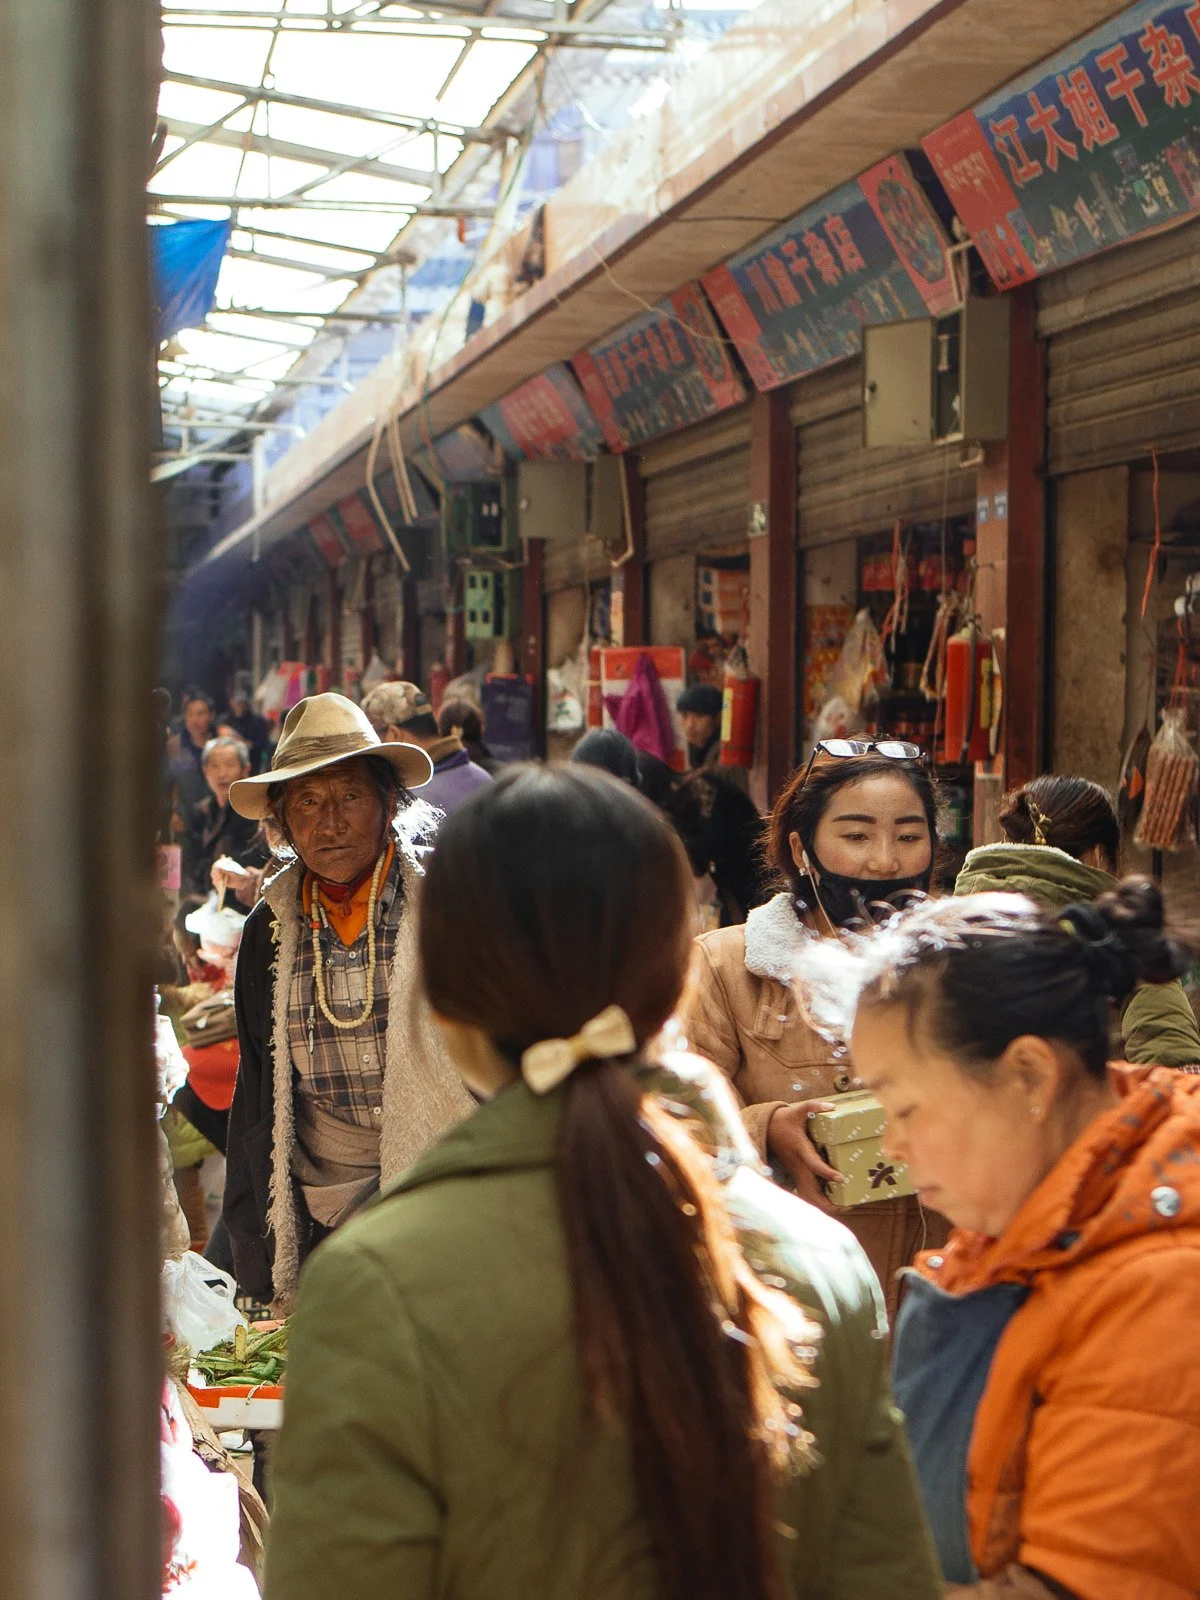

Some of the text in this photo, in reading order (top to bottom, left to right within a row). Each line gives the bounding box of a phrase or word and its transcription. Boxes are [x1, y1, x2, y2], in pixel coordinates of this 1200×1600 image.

[989, 0, 1200, 188] 江大姐干杂
